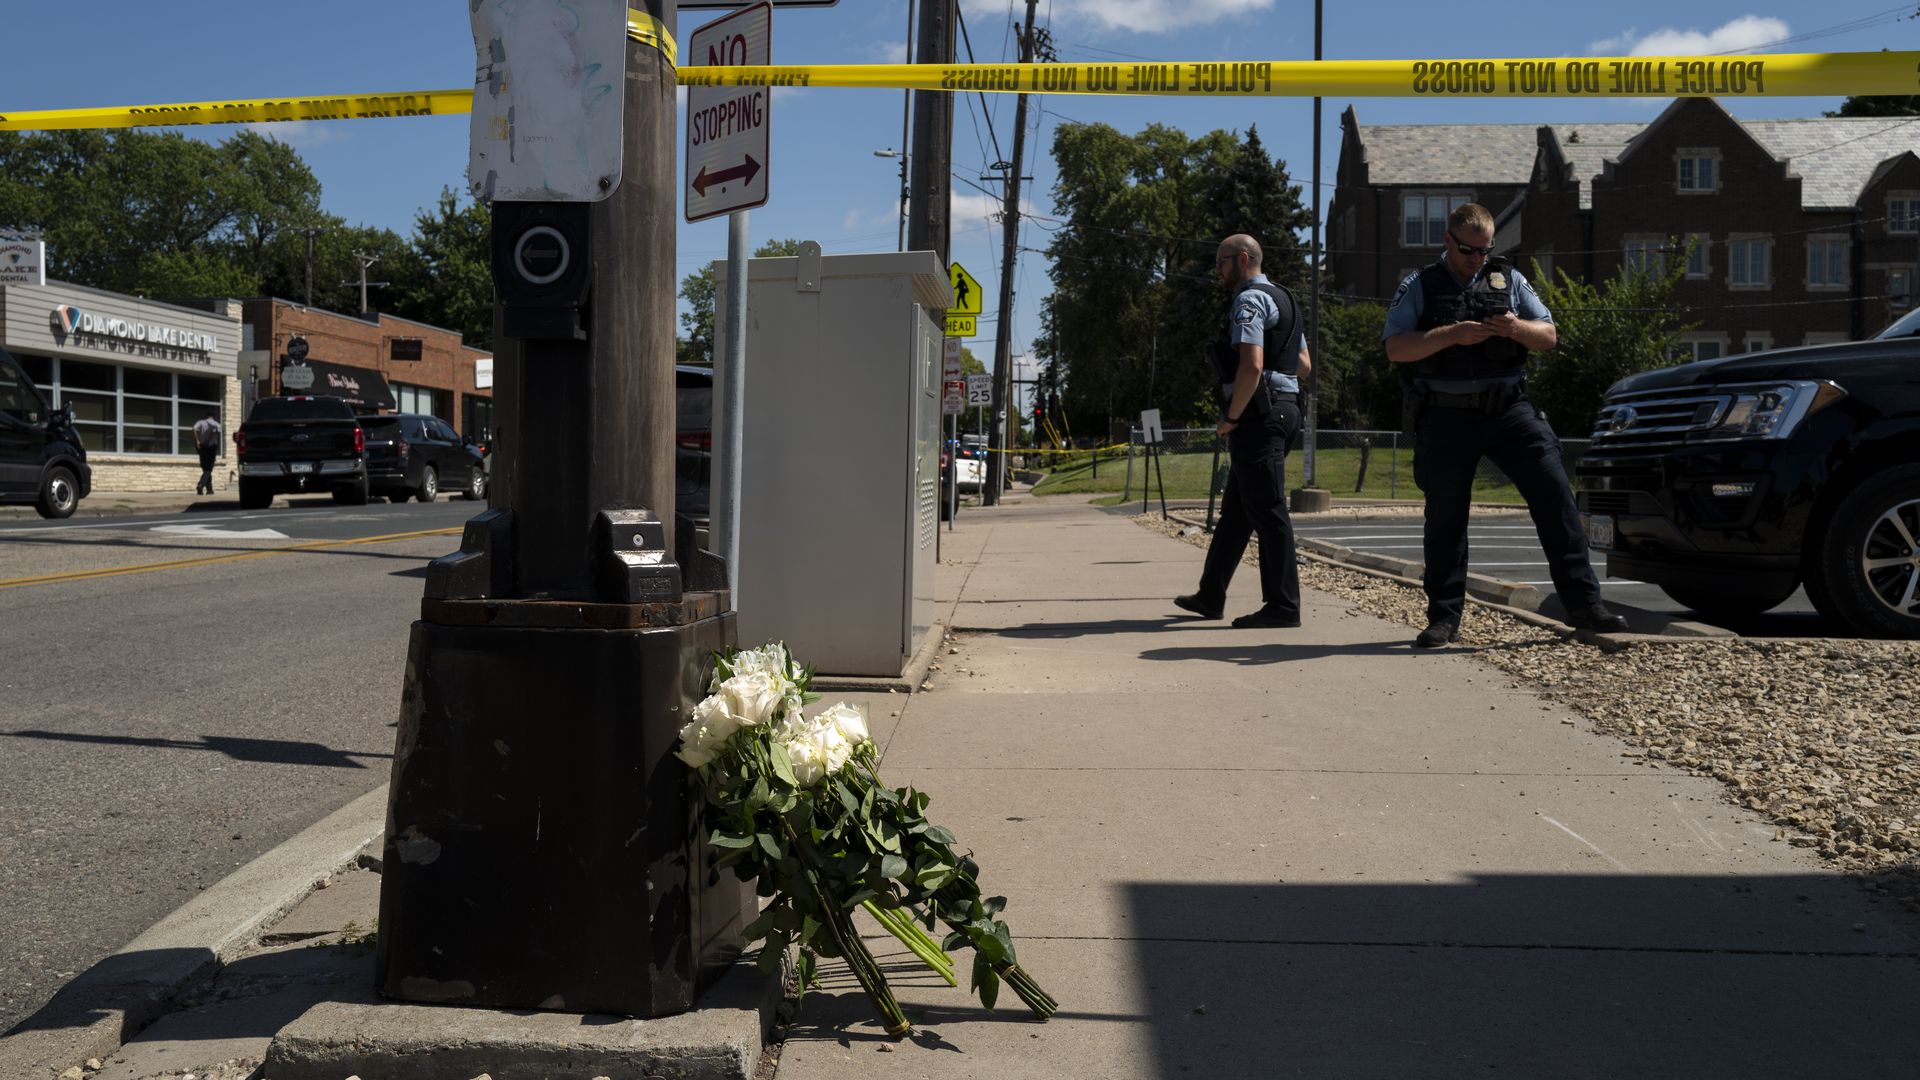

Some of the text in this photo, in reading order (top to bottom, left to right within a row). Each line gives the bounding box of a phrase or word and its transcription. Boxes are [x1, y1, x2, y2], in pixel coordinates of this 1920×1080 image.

[708, 33, 747, 67] NO
[693, 91, 762, 146] STOPPING
[83, 313, 220, 353] DIAMOND LAKE DENTAL
[946, 320, 972, 331] HEAD
[970, 390, 991, 403] 25
